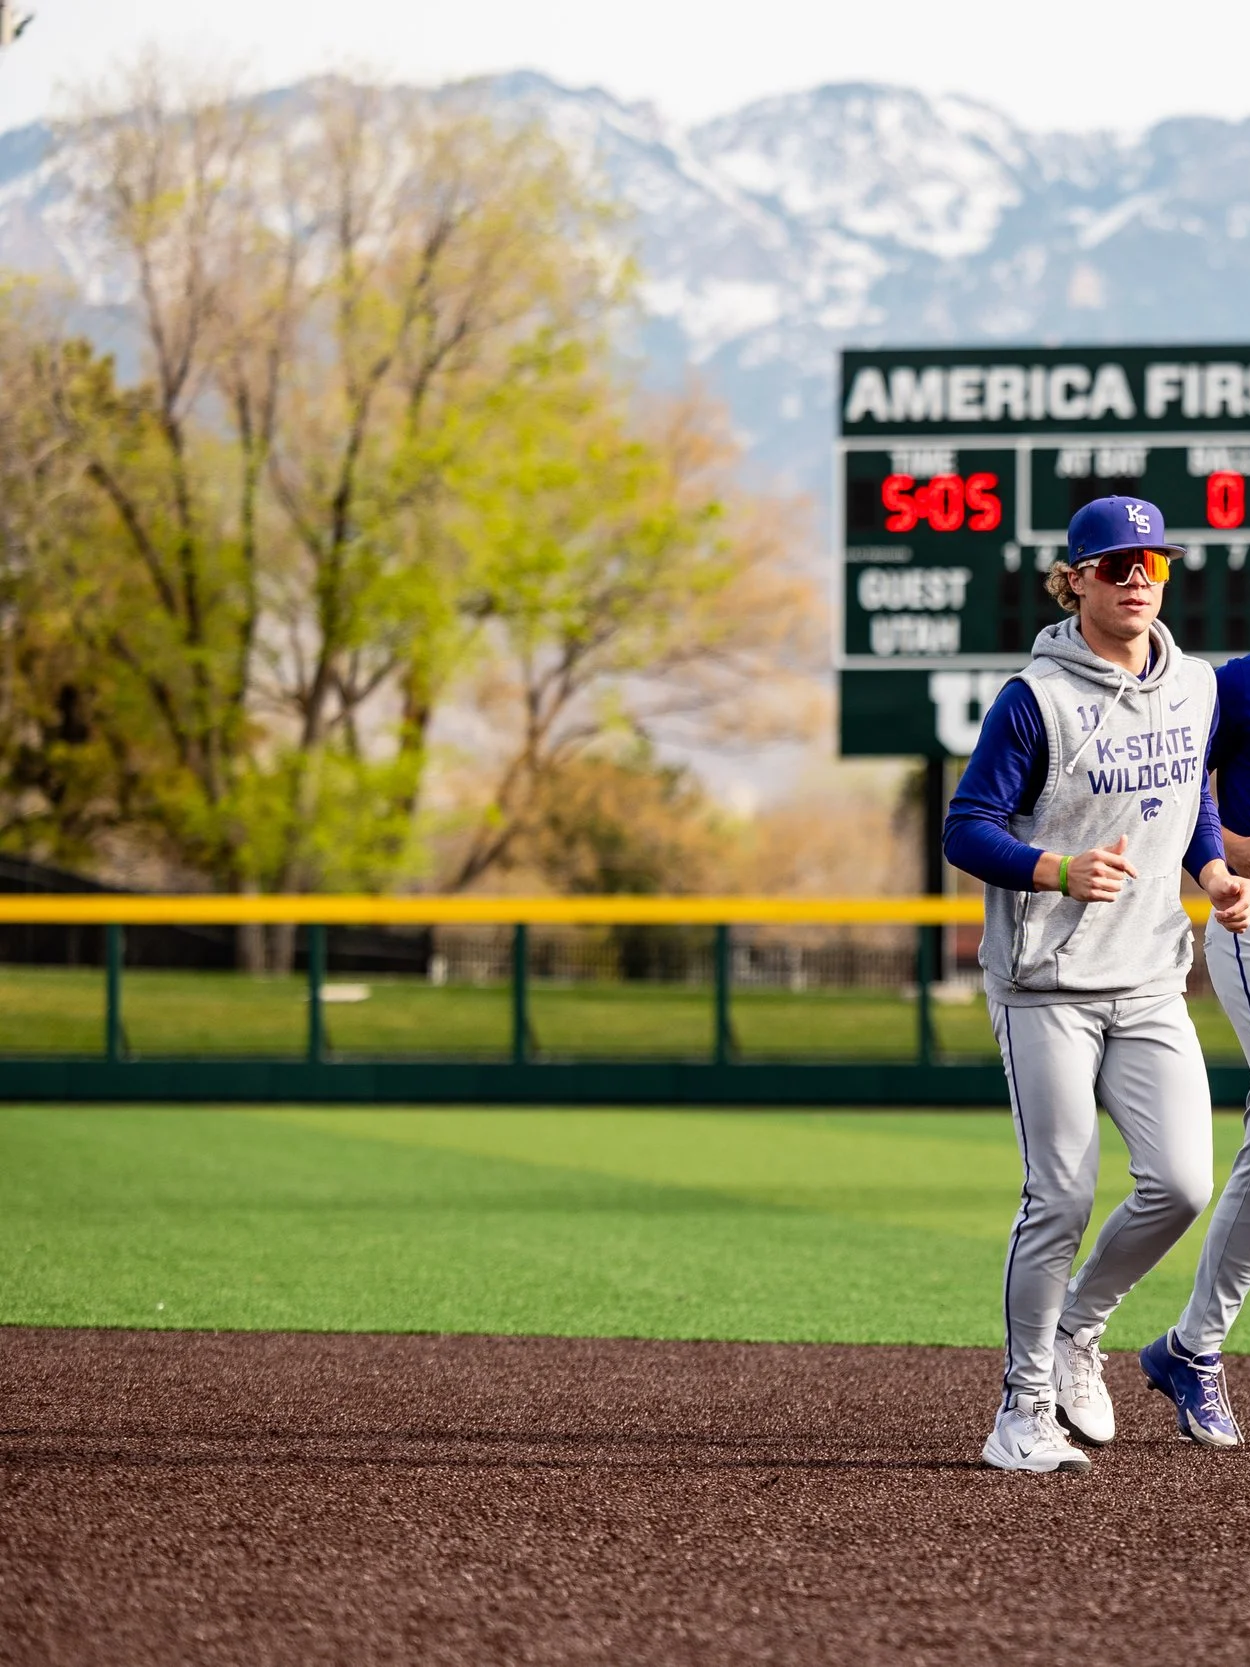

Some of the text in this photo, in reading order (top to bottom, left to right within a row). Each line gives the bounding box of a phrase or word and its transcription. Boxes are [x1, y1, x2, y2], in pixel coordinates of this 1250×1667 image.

[845, 363, 1135, 423] AMERICA
[888, 443, 959, 477] TIME
[1055, 442, 1092, 478] AT
[1206, 470, 1246, 530] 0
[857, 567, 972, 612] GUEST
[869, 613, 961, 655] UTAH
[1077, 704, 1104, 731] 11
[1096, 726, 1194, 765] K-STATE
